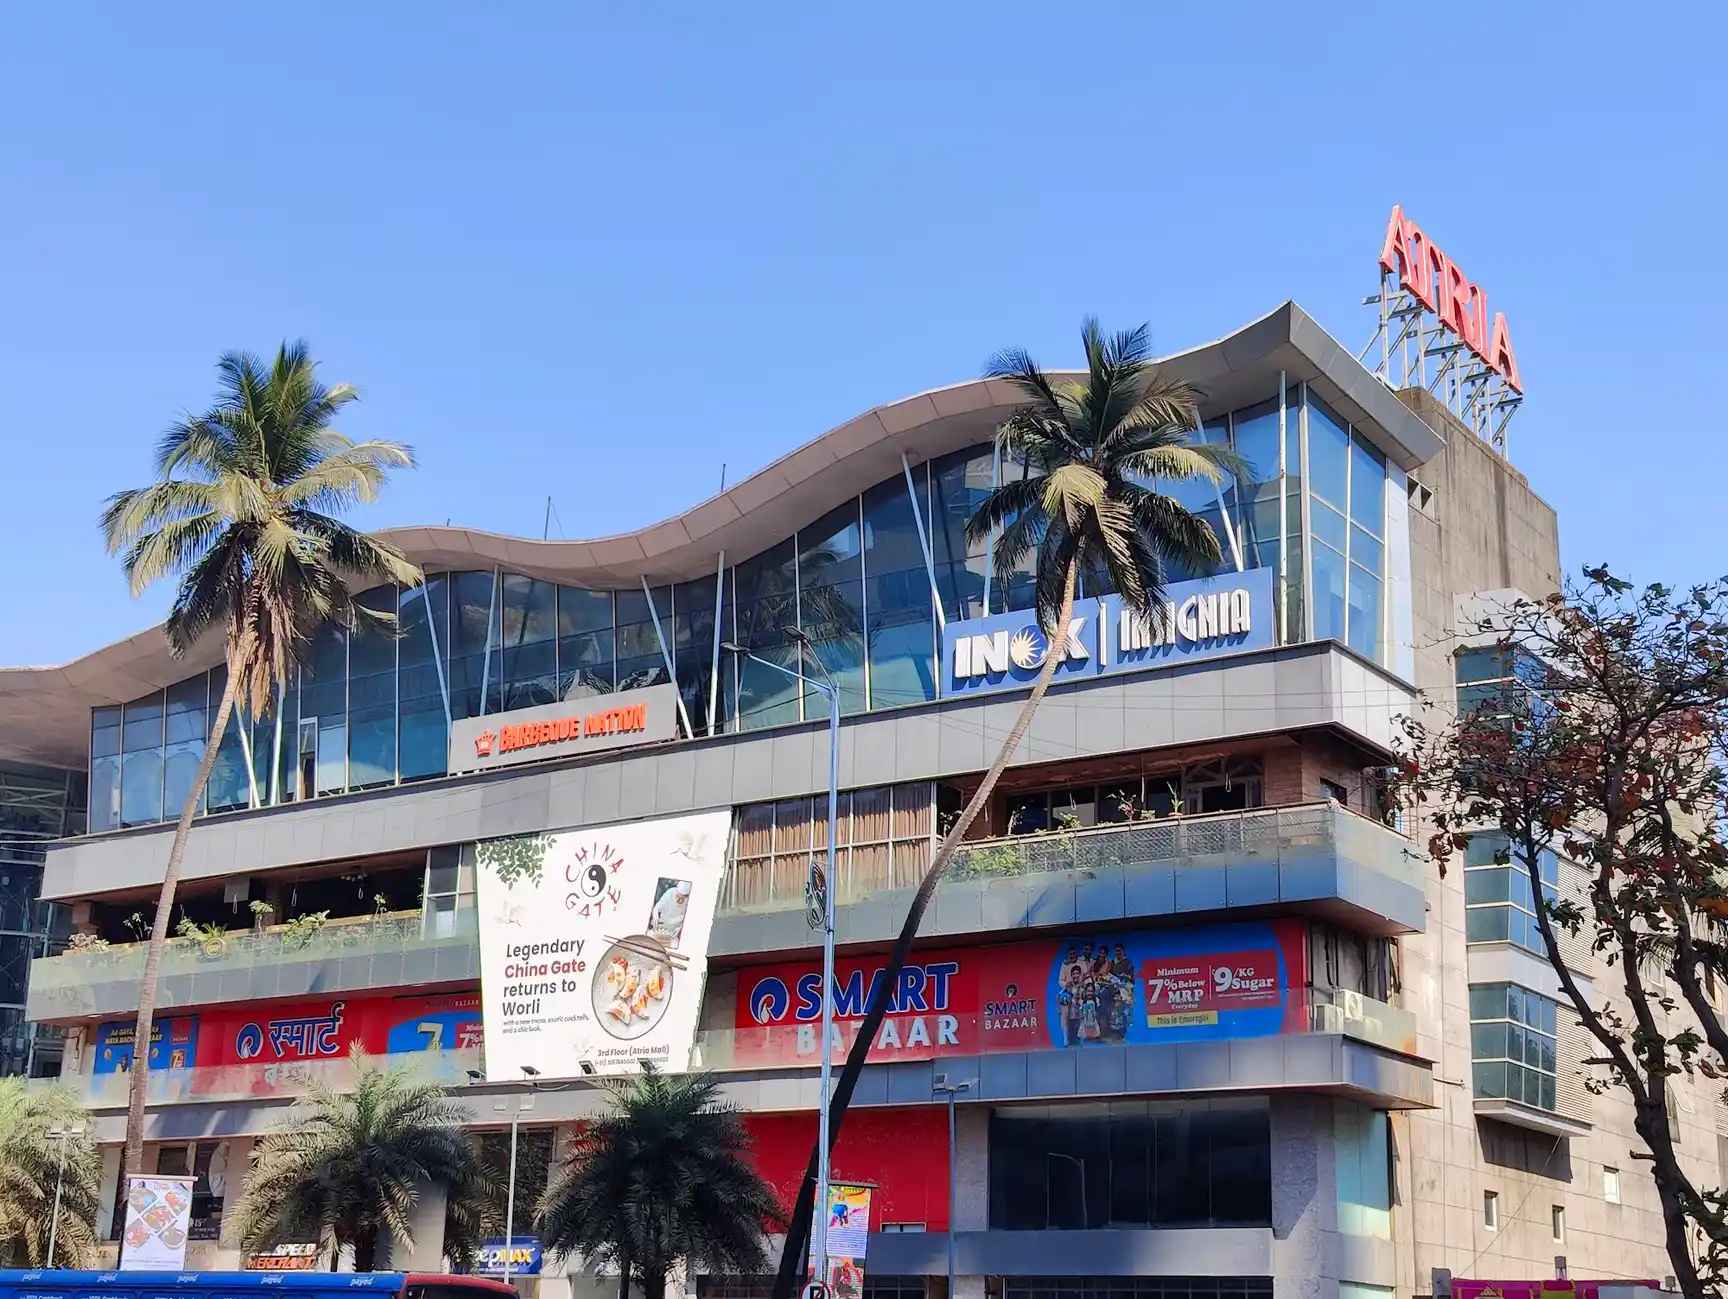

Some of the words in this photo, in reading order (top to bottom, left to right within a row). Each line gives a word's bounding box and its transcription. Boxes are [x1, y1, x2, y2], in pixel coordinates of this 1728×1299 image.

[1379, 204, 1523, 396] ATRIA
[955, 617, 1089, 679] INOX
[499, 714, 580, 753] BARBEQUE
[584, 703, 647, 737] NATION
[565, 841, 624, 883] CHINA
[506, 938, 585, 961] Legendary
[504, 961, 548, 978] China
[551, 959, 586, 975] Gate
[1157, 967, 1199, 977] Minimum
[503, 982, 557, 998] returns
[562, 978, 577, 992] to
[796, 961, 960, 1021] SMART
[1178, 979, 1205, 989] Below
[1231, 978, 1274, 991] Sugar
[1167, 989, 1204, 1003] MRP
[502, 998, 540, 1016] Worli
[985, 999, 1037, 1016] SMART
[268, 1001, 345, 1057] स्मार्ट
[985, 1017, 1037, 1030] BAZAAR
[796, 1014, 960, 1055] BAAAR
